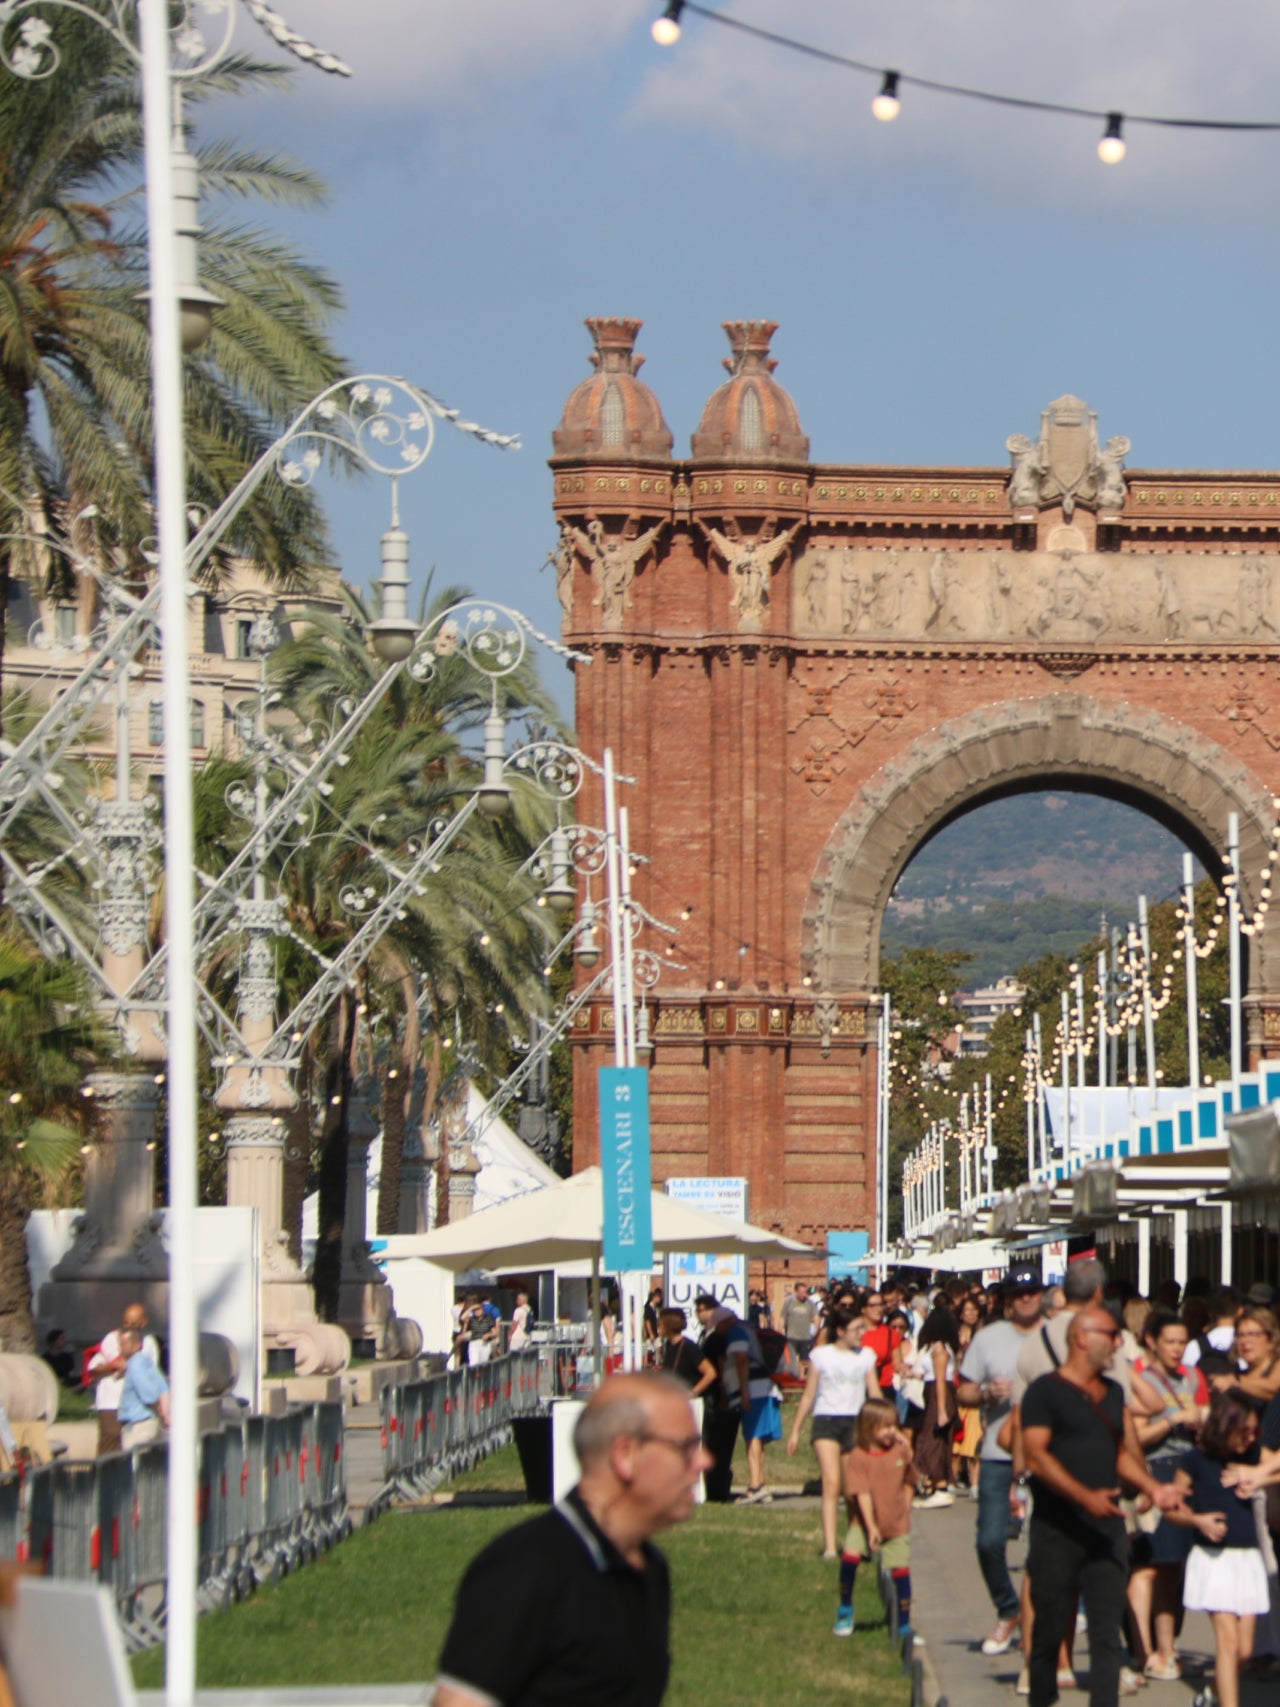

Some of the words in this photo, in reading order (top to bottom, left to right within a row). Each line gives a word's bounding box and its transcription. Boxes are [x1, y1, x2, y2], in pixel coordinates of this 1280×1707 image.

[614, 1084, 631, 1102] 3
[615, 1112, 635, 1246] ESCENARI
[672, 1180, 686, 1188] LA
[689, 1180, 741, 1188] LECTURA
[672, 1283, 741, 1303] UNA
